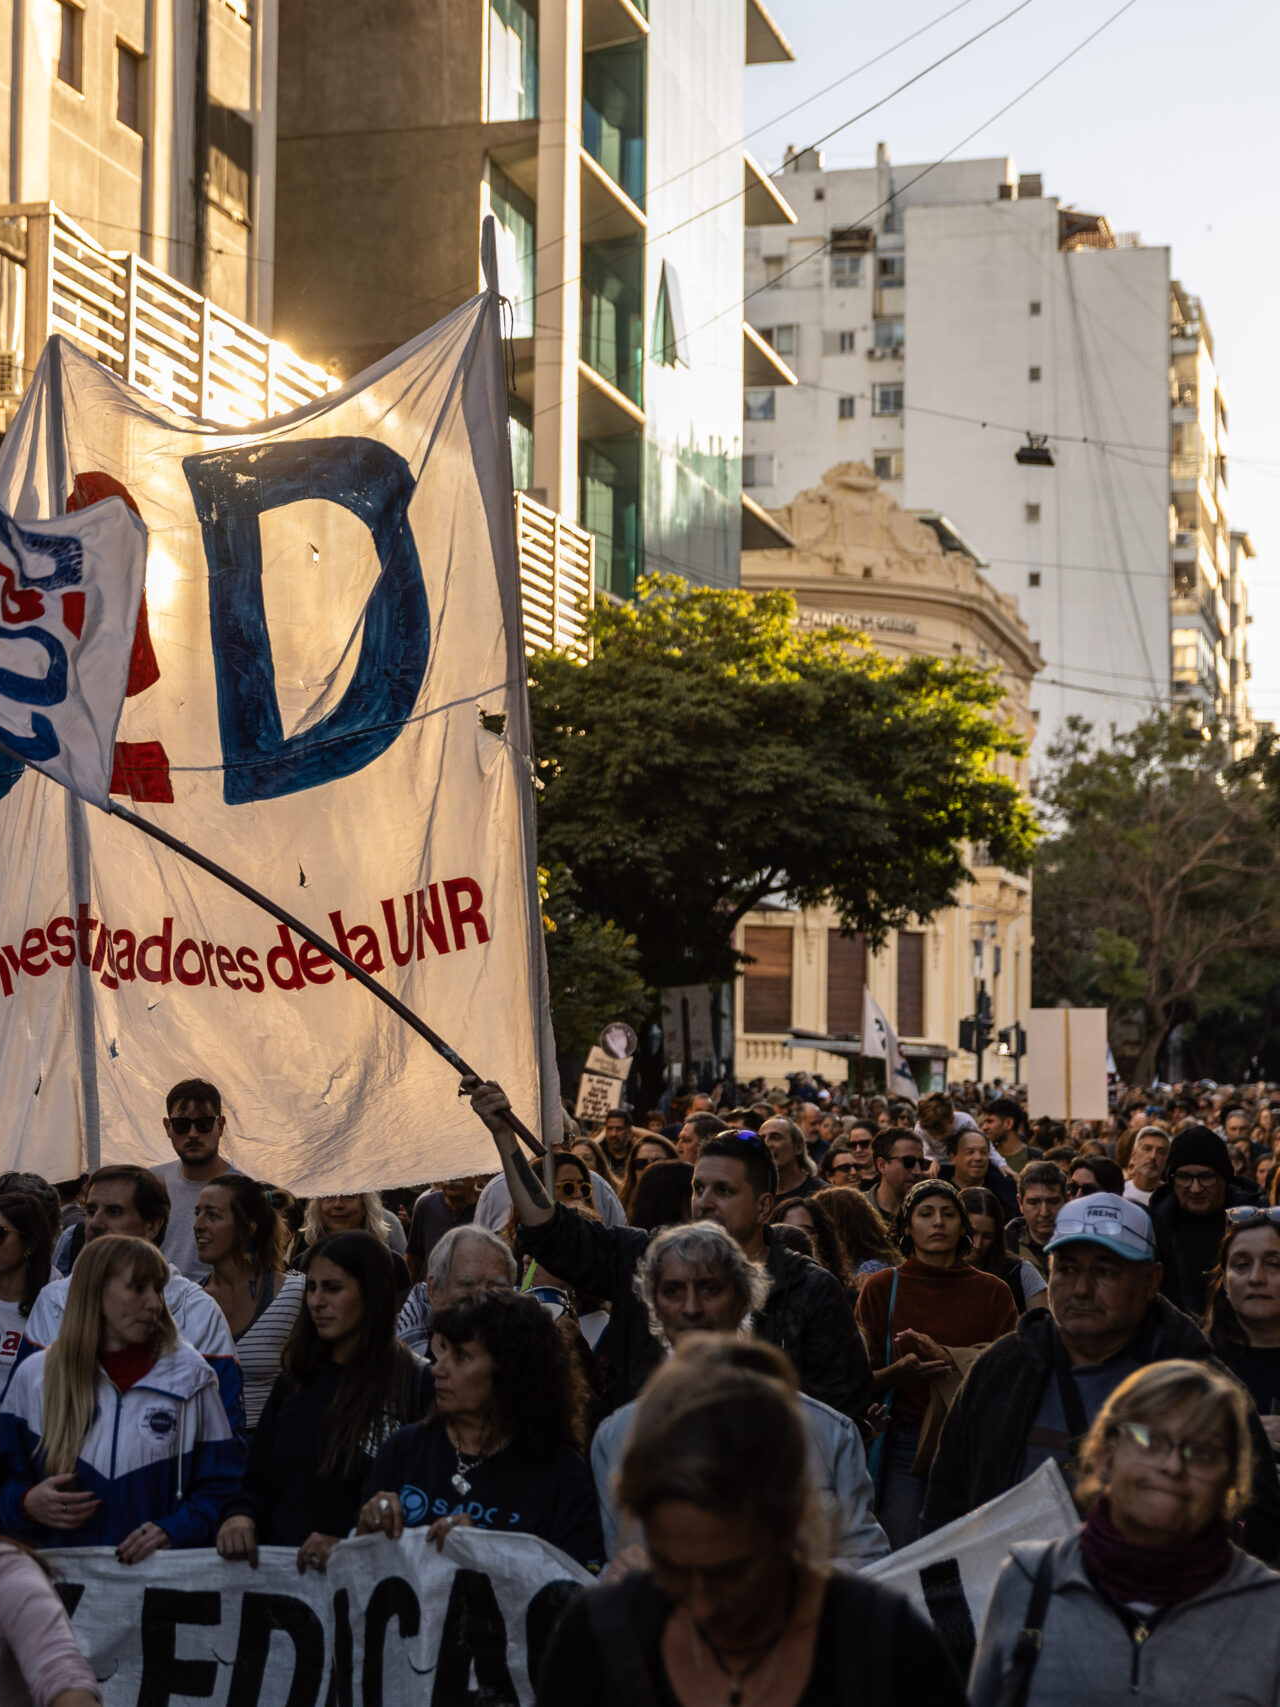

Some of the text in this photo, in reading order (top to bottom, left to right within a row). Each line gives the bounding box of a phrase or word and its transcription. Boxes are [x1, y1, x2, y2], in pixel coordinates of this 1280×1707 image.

[267, 922, 336, 992] de
[328, 910, 383, 980] la
[382, 876, 489, 967] UNR
